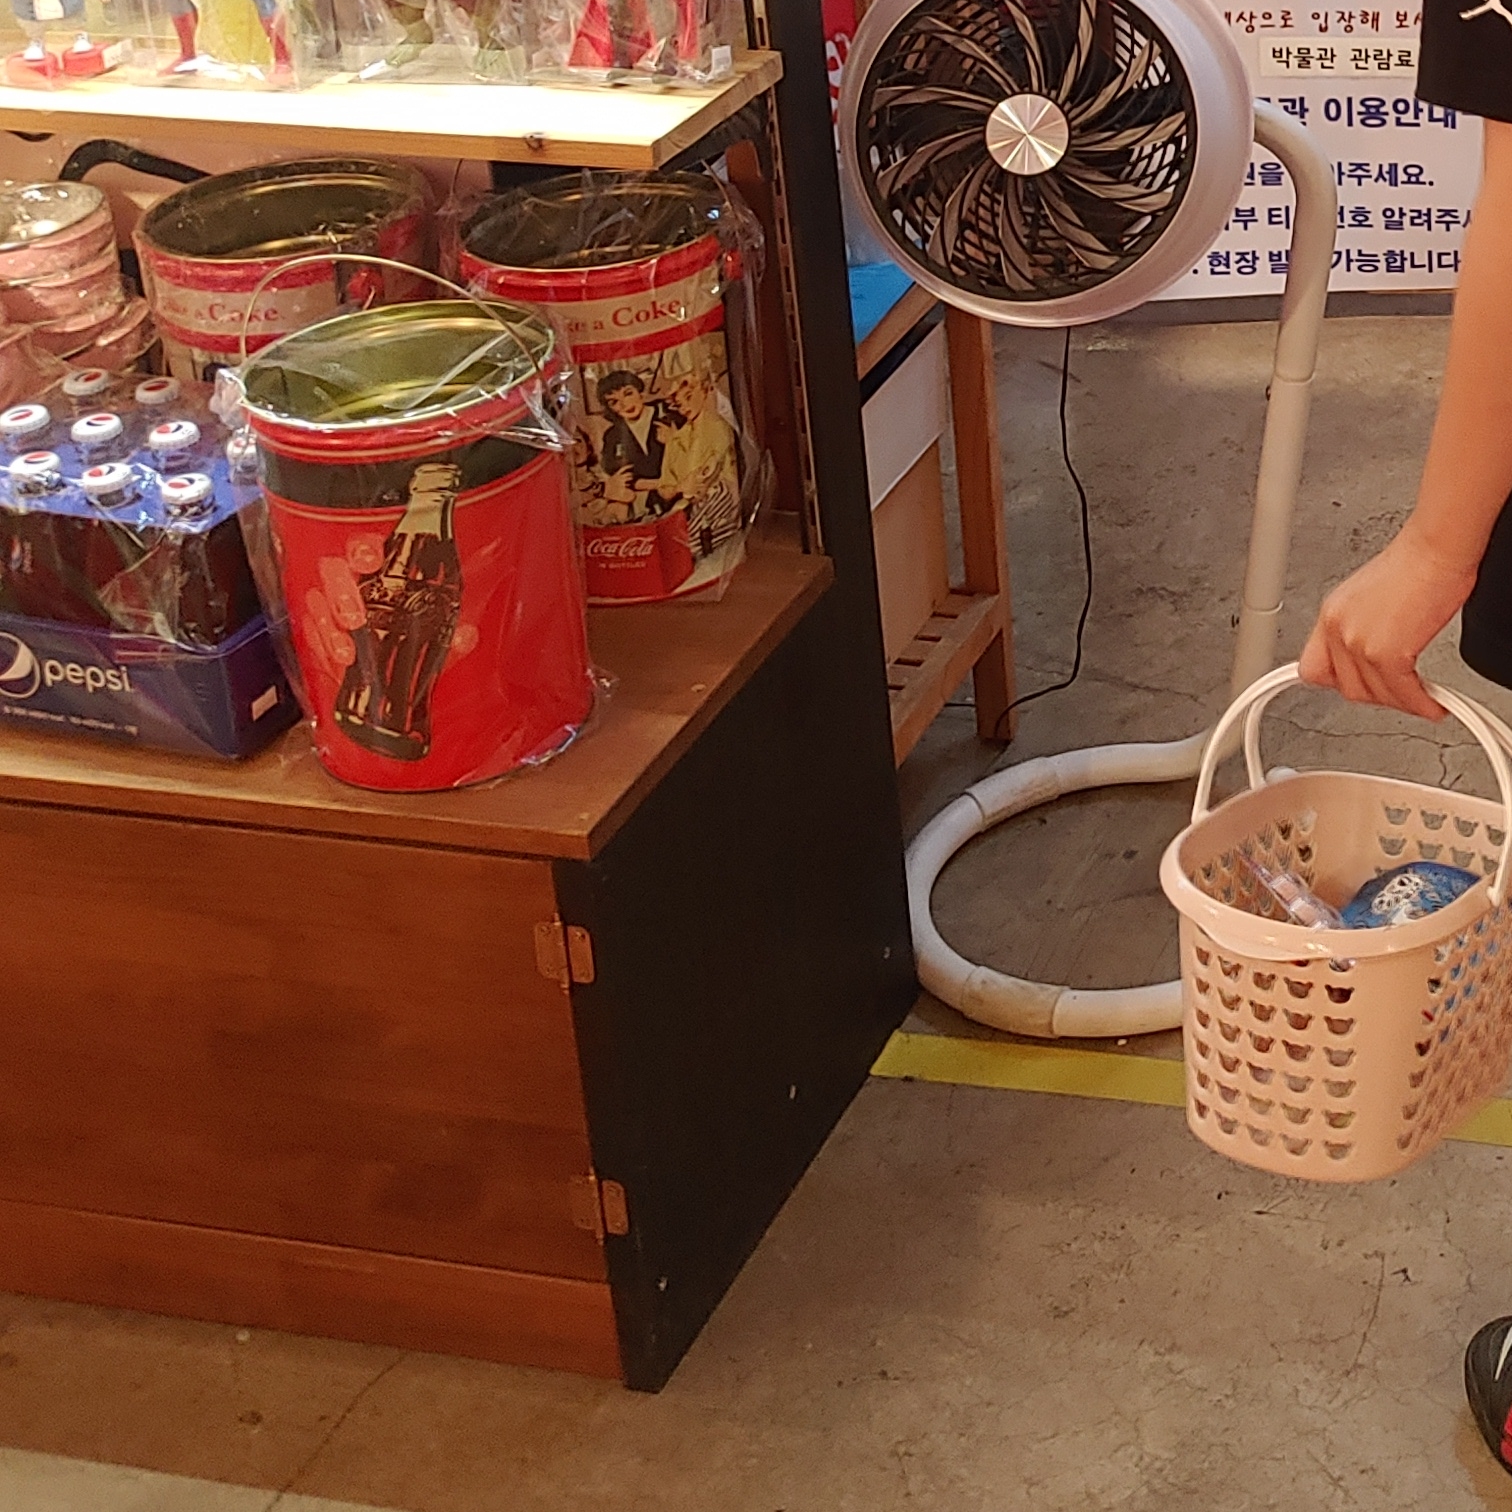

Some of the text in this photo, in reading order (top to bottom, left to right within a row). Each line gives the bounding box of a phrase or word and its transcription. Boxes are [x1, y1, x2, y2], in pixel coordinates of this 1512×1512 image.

[1311, 9, 1381, 34] 입장해
[1271, 46, 1416, 71] 박물관 관람료
[1207, 250, 1258, 276] 현장
[611, 298, 681, 327] Coke
[586, 539, 655, 560] Coca-Cola
[43, 658, 133, 694] pepsi
